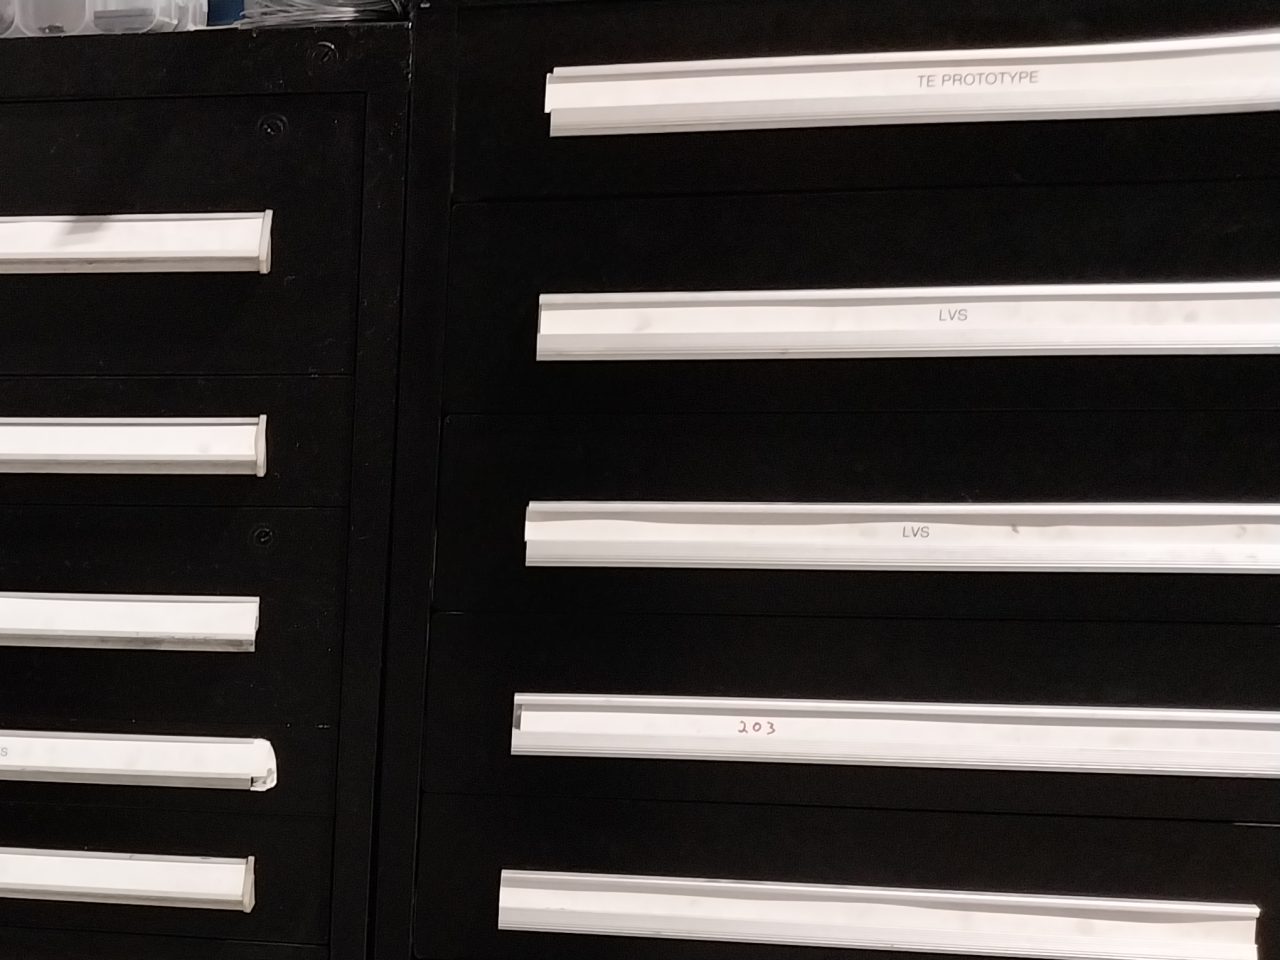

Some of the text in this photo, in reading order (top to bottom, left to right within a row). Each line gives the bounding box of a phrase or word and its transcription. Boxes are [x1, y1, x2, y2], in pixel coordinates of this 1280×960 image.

[918, 70, 1039, 88] TE PROTOTYPE
[939, 308, 968, 321] LVS
[902, 526, 930, 538] LVS
[737, 720, 776, 735] 203
